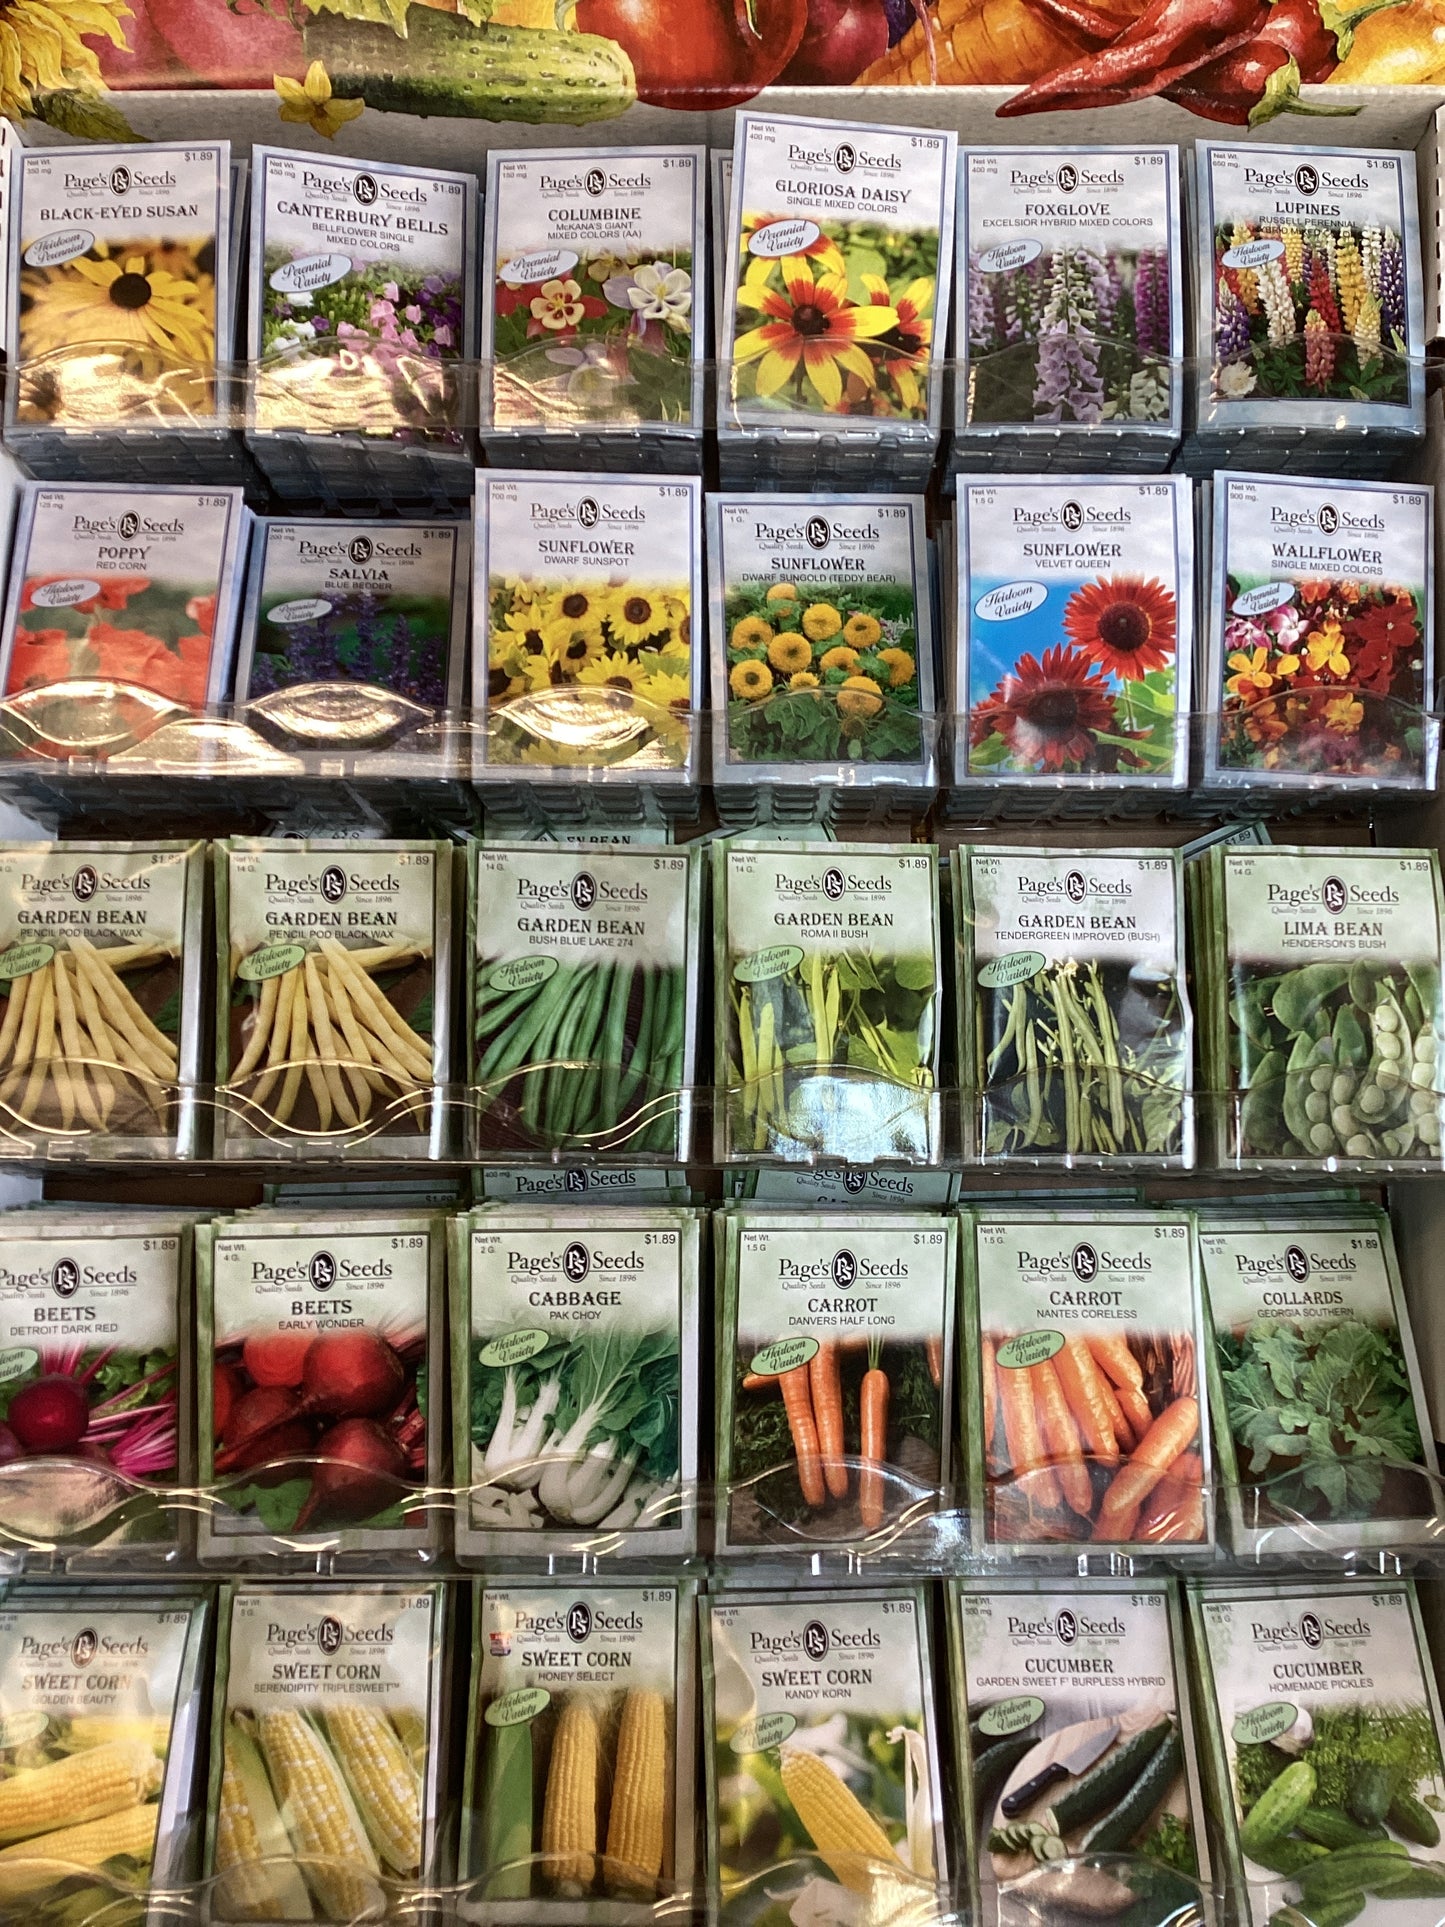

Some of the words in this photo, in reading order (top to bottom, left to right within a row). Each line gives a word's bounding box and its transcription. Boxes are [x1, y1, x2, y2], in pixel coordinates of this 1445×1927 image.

[185, 152, 212, 161] $1.89
[1135, 157, 1163, 165] $1.89
[540, 175, 582, 192] Page's
[609, 174, 651, 187] Seeds
[1244, 168, 1293, 187] Page's
[1322, 173, 1368, 189] Seeds
[776, 180, 855, 199] GLORIOSA
[862, 187, 912, 203] DAISY
[787, 197, 821, 207] SINGLE
[825, 200, 855, 210] MIXED
[858, 203, 897, 214] COLORS
[1025, 203, 1110, 215] FOXGLOVE
[1275, 201, 1340, 216] LUPINES
[40, 206, 141, 221] BLACK-EYED
[146, 205, 198, 218] SUSAN
[277, 201, 392, 227] CANTERBURY
[396, 218, 448, 235] BELLS
[549, 208, 641, 221] COLUMBINE
[983, 218, 1038, 227] EXCELSIOR
[1040, 218, 1076, 226] HYBRID
[1080, 218, 1109, 226] MIXED
[1259, 216, 1301, 225] RUSSELL
[1304, 218, 1357, 228] PERENNIAL
[312, 223, 377, 238] BELLFLOWER
[379, 231, 414, 243] SINGLE
[548, 231, 577, 239] MIXED
[580, 231, 619, 239] COLORS
[623, 230, 642, 239] (AA)
[327, 235, 357, 247] MIXED
[360, 239, 400, 252] COLORS
[659, 487, 688, 497] $1.89
[1393, 494, 1421, 505] $1.89
[755, 523, 804, 539] Page's
[833, 525, 879, 538] Seeds
[98, 547, 151, 559] POPPY
[539, 540, 634, 555] SUNFLOWER
[1024, 544, 1121, 556] SUNFLOWER
[1272, 543, 1382, 564] WALLFLOWER
[119, 562, 147, 570] CORN
[544, 556, 580, 564] DWARF
[582, 556, 629, 565] SUNSPOT
[771, 557, 865, 570] SUNFLOWER
[1036, 560, 1073, 568] VELVET
[1075, 560, 1110, 568] QUEEN
[329, 568, 388, 580] SALVIA
[1272, 560, 1307, 570] SINGLE
[1310, 563, 1340, 572] MIXED
[1343, 565, 1383, 575] COLORS
[742, 573, 777, 581] DWARF
[780, 574, 826, 582] SUNGOLD
[829, 574, 864, 582] (TEDDY
[867, 574, 896, 582] BEAR)
[325, 581, 349, 589] BLUE
[654, 859, 684, 870] $1.89
[1139, 861, 1167, 870] $1.89
[266, 874, 318, 896] Page's
[349, 874, 399, 891] Seeds
[775, 874, 820, 893] Page's
[848, 875, 891, 890] Seeds
[18, 910, 91, 924] GARDEN
[97, 910, 147, 924] BEAN
[266, 911, 341, 925] GARDEN
[348, 911, 397, 925] BEAN
[774, 913, 843, 926] GARDEN
[848, 913, 893, 926] BEAN
[1019, 915, 1085, 928] GARDEN
[1090, 917, 1136, 928] BEAN
[518, 918, 591, 933] GARDEN
[597, 920, 645, 934] BEAN
[1284, 921, 1328, 935] LIMA
[1334, 923, 1383, 935] BEAN
[269, 930, 306, 938] PENCIL
[309, 930, 332, 938] POD
[335, 930, 368, 938] BLACK
[371, 930, 393, 938] WAX
[995, 932, 1070, 940] TENDERGREEN
[1072, 932, 1125, 941] IMPROVED
[1128, 932, 1160, 942] (BUSH)
[529, 935, 558, 944] BUSH
[561, 936, 586, 945] BLUE
[589, 937, 614, 946] LAKE
[617, 939, 633, 947] 274
[1282, 940, 1355, 948] HENDERSON'S
[1359, 940, 1386, 948] BUSH
[391, 1238, 422, 1248] $1.89
[1351, 1239, 1377, 1249] $1.89
[507, 1252, 560, 1274] Page's
[593, 1251, 644, 1269] Seeds
[1018, 1252, 1069, 1274] Page's
[1101, 1252, 1151, 1270] Seeds
[529, 1292, 621, 1306] CABBAGE
[1050, 1291, 1122, 1306] CARROT
[1264, 1291, 1343, 1305] COLLARDS
[292, 1300, 352, 1315] BEETS
[808, 1298, 878, 1313] CARROT
[34, 1307, 96, 1322] BEETS
[572, 1312, 602, 1320] CHOY
[1037, 1310, 1079, 1318] NANTES
[1081, 1309, 1137, 1318] CORELESS
[1257, 1309, 1300, 1318] GEORGIA
[1303, 1308, 1354, 1317] SOUTHERN
[278, 1321, 312, 1330] EARLY
[315, 1319, 364, 1328] WONDER
[789, 1317, 837, 1325] DANVERS
[840, 1316, 865, 1324] HALF
[868, 1316, 895, 1325] LONG
[10, 1327, 58, 1336] DETROIT
[61, 1325, 92, 1334] DARK
[95, 1323, 117, 1332] RED
[1132, 1596, 1161, 1606] $1.89
[883, 1603, 912, 1613] $1.89
[1251, 1623, 1297, 1644] Page's
[1325, 1619, 1371, 1636] Seeds
[522, 1650, 582, 1666] SWEET
[587, 1653, 632, 1667] CORN
[272, 1662, 332, 1679] SWEET
[336, 1665, 380, 1679] CORN
[1025, 1659, 1113, 1673] CUCUMBER
[1273, 1661, 1363, 1679] CUCUMBER
[538, 1672, 574, 1681] HONEY
[576, 1672, 615, 1680] SELECT
[762, 1669, 822, 1687] SWEET
[827, 1670, 872, 1684] CORN
[977, 1677, 1020, 1686] GARDEN
[1022, 1678, 1057, 1686] SWEET
[1072, 1677, 1125, 1686] BURPLESS
[1128, 1677, 1165, 1686] HYBRID
[254, 1683, 318, 1693] SERENDIPITY
[1269, 1680, 1329, 1693] HOMEMADE
[1331, 1679, 1373, 1690] PICKLES
[785, 1690, 819, 1699] KANDY
[822, 1689, 851, 1698] KORN
